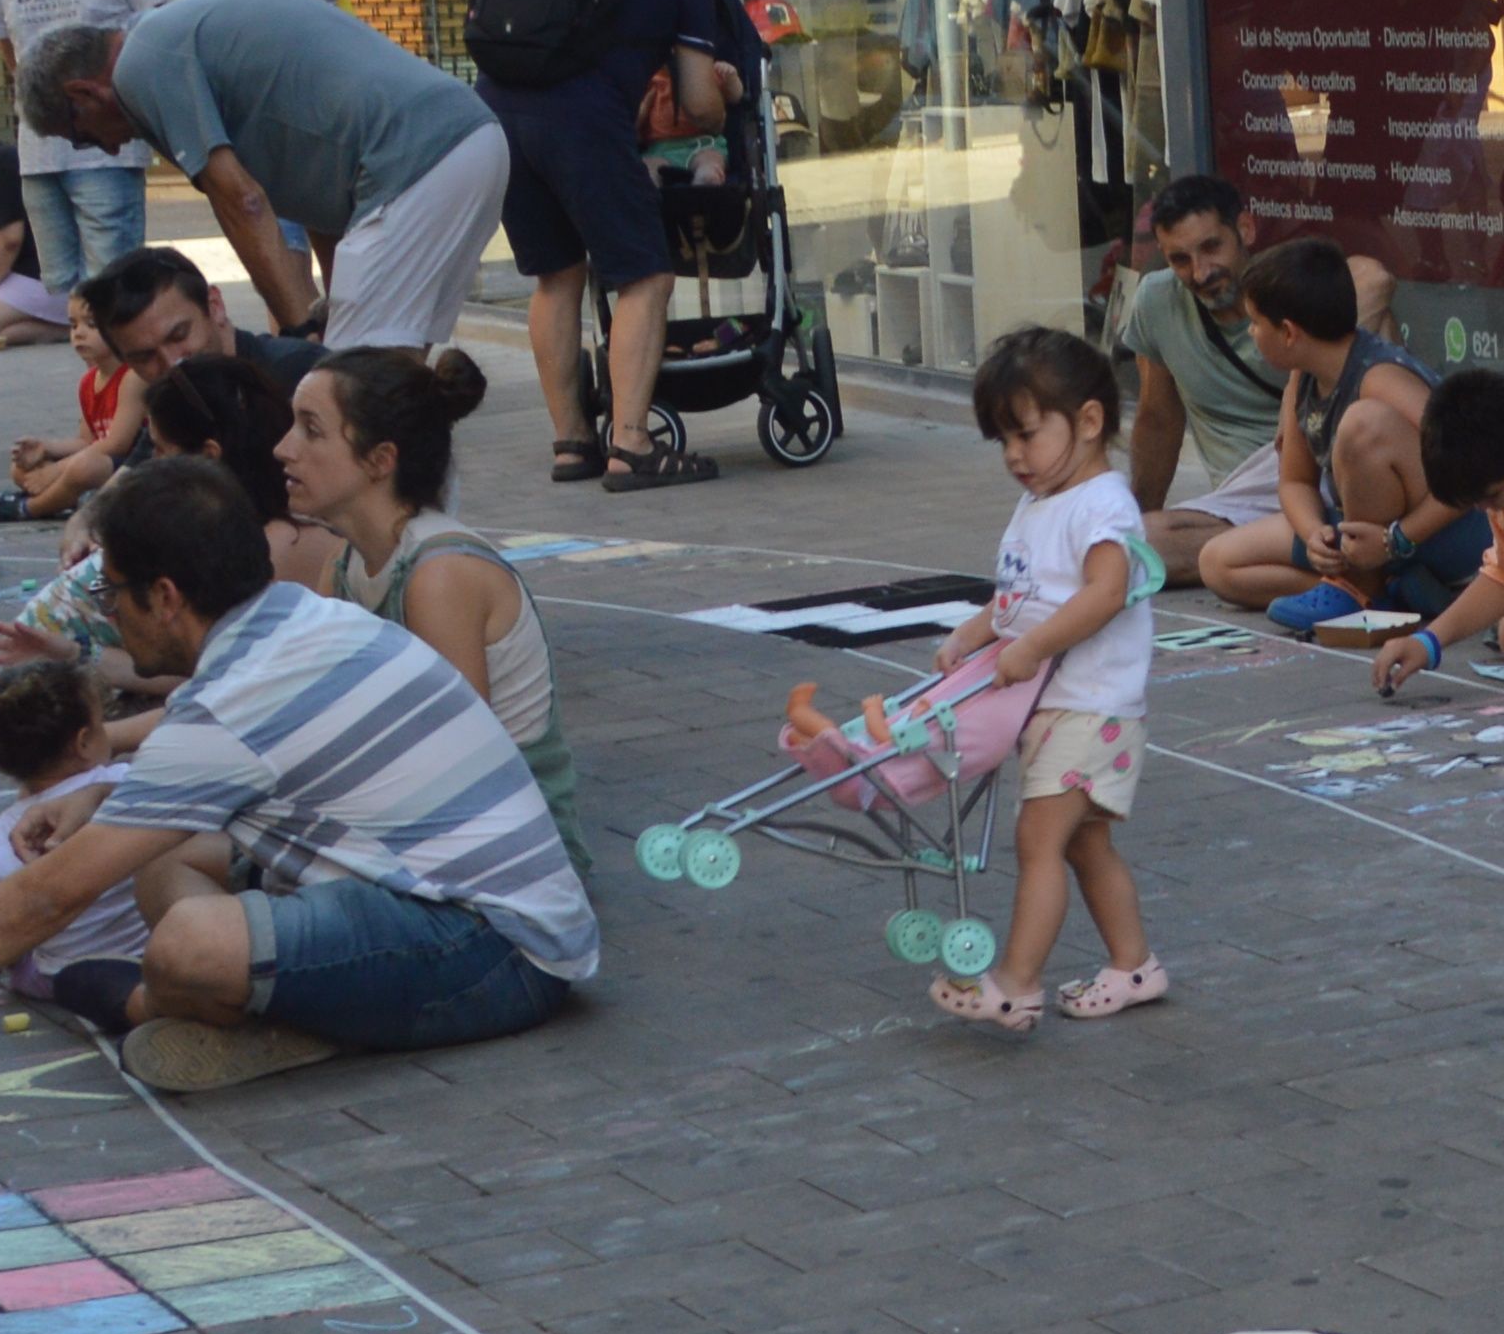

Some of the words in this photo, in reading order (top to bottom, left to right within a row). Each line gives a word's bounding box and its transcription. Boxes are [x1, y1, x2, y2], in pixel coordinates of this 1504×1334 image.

[1240, 28, 1258, 47] Llei
[1259, 29, 1272, 47] de
[1273, 28, 1311, 51] Segona
[1312, 27, 1371, 51] Oportunitat
[1383, 27, 1426, 48] Divorcis
[1434, 28, 1490, 49] Herències
[1242, 72, 1294, 91] Concursos
[1296, 73, 1310, 91] de
[1310, 73, 1356, 92] creditors
[1385, 74, 1447, 95] Planificació
[1448, 74, 1478, 94] fiscal
[1388, 121, 1452, 142] Inspeccions
[1246, 158, 1315, 179] Compravenda
[1316, 161, 1376, 182] d'empreses
[1390, 162, 1452, 185] Hipoteques
[1249, 200, 1292, 220] Préstecs
[1294, 202, 1334, 222] abusius
[1393, 208, 1475, 232] Assessorament
[1476, 212, 1503, 236] legal
[1472, 331, 1499, 359] 621
